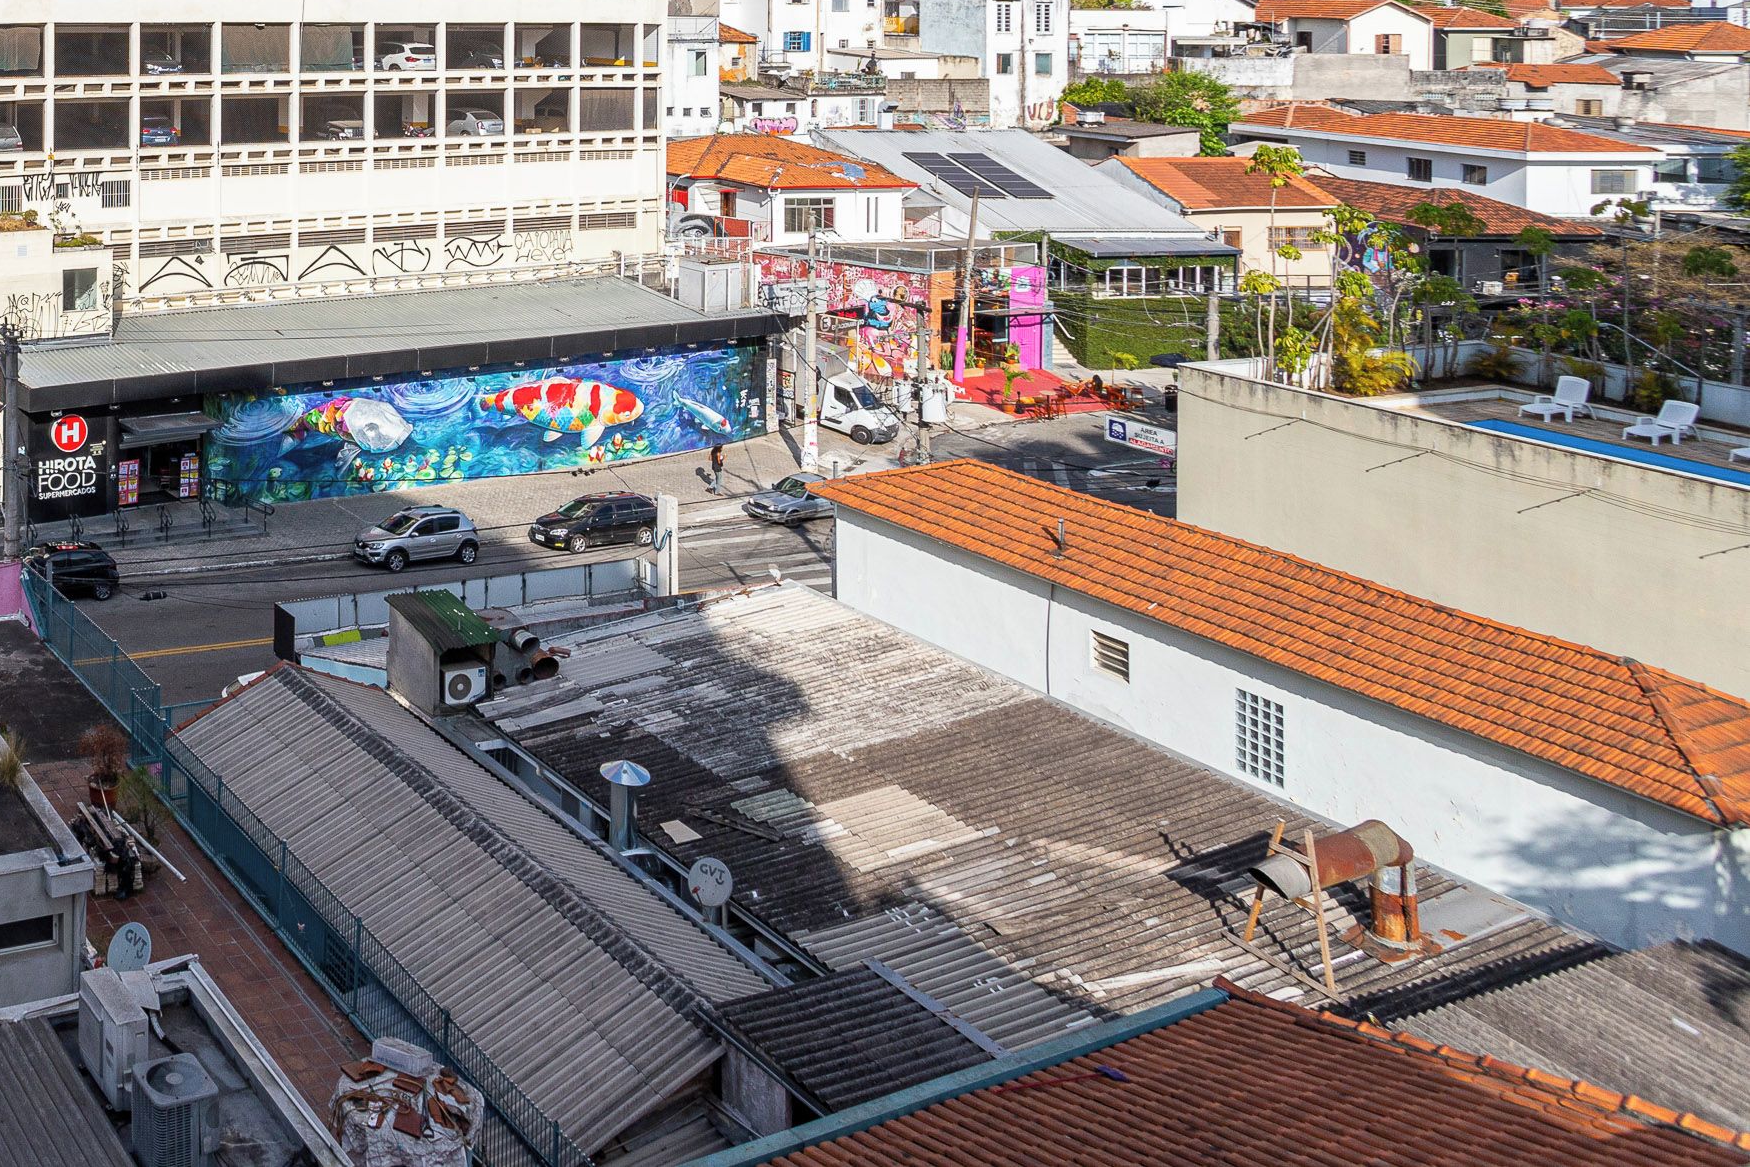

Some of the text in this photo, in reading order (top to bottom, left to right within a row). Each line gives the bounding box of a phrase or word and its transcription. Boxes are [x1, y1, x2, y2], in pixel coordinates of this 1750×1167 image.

[61, 421, 80, 444] H
[38, 456, 96, 475] HIROTA
[38, 470, 96, 493] FOOD
[38, 486, 96, 500] SUPERMERCADOS
